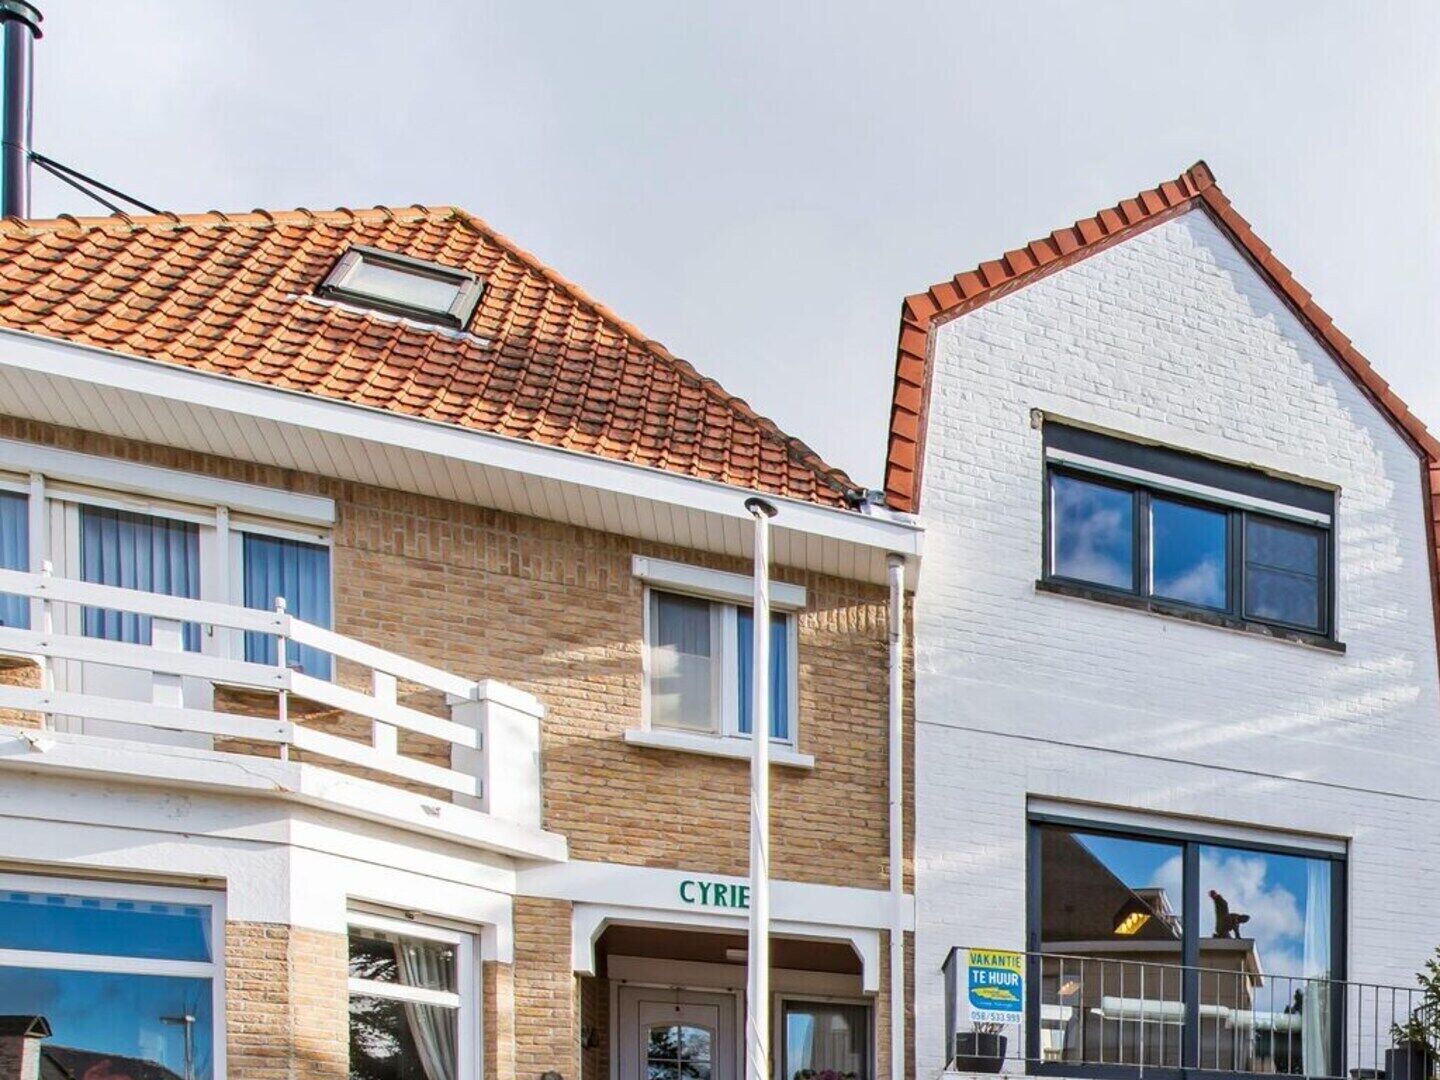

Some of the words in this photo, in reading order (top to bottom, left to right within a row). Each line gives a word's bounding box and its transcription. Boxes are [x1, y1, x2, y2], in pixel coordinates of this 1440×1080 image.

[970, 952, 1022, 968] VAKANTIE
[972, 970, 986, 984] TE
[989, 972, 1019, 986] HUUR
